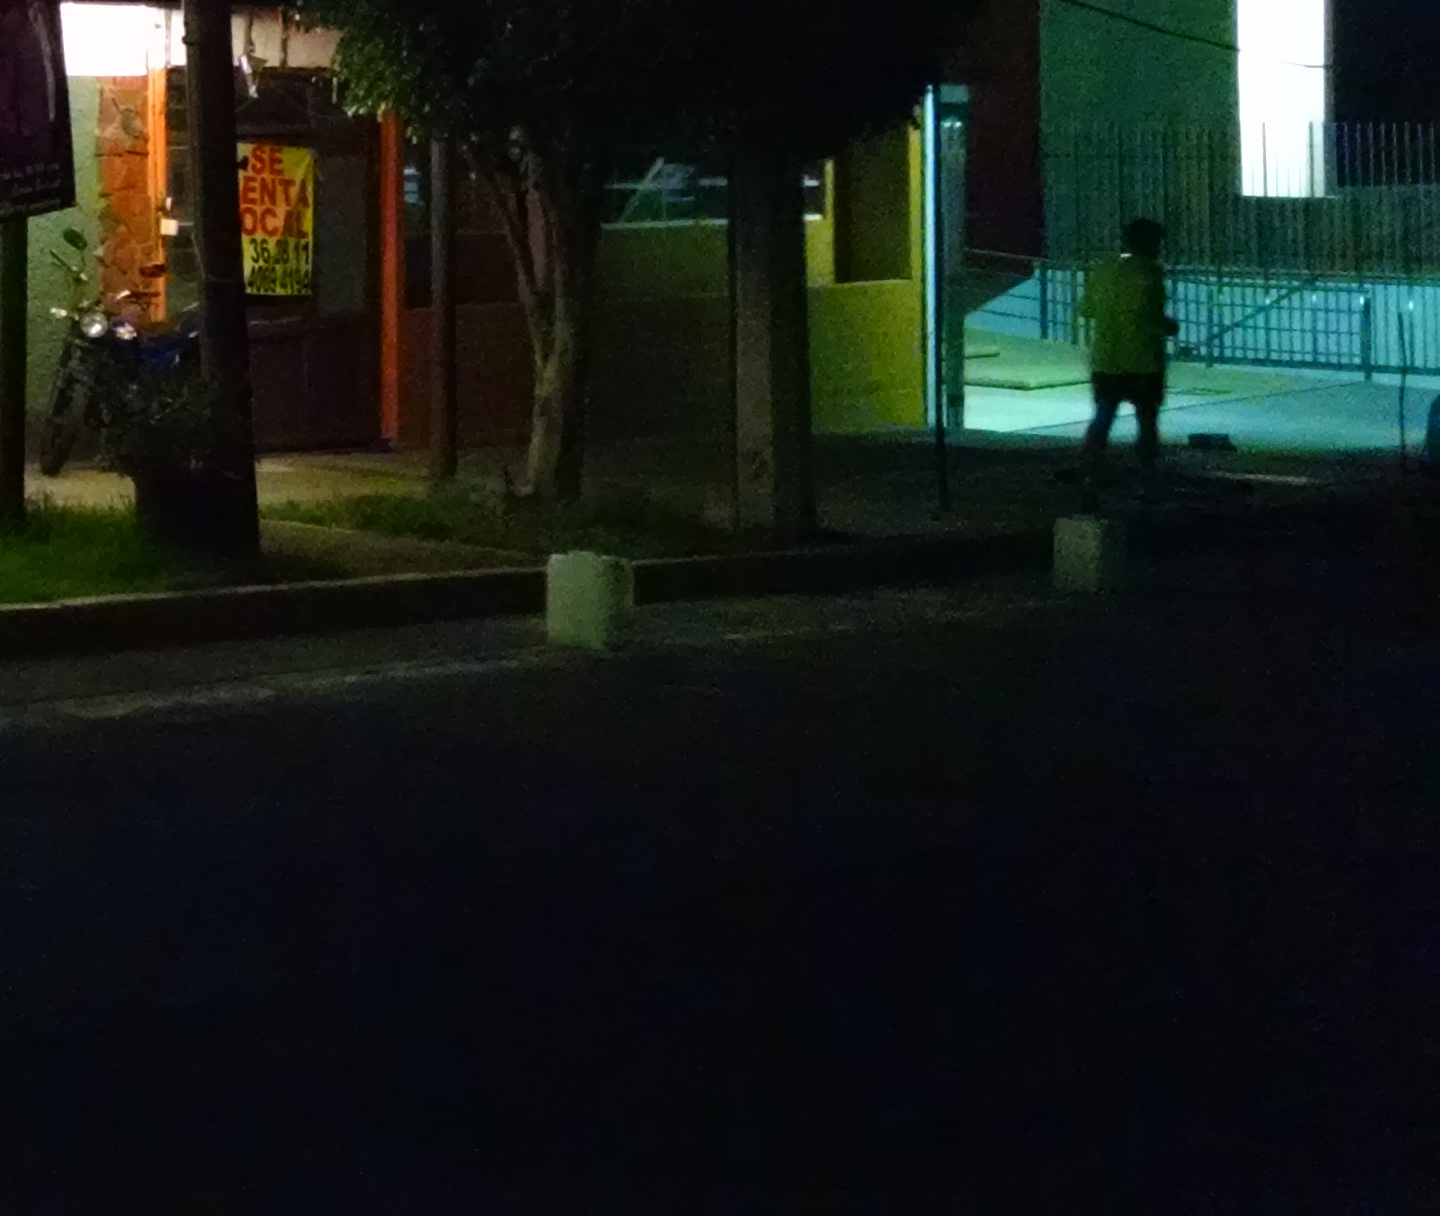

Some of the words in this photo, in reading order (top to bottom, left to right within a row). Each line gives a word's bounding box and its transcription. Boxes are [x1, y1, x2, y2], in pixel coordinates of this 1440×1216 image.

[250, 142, 285, 176] SE
[241, 176, 311, 208] ENTA
[240, 206, 310, 239] OCAL
